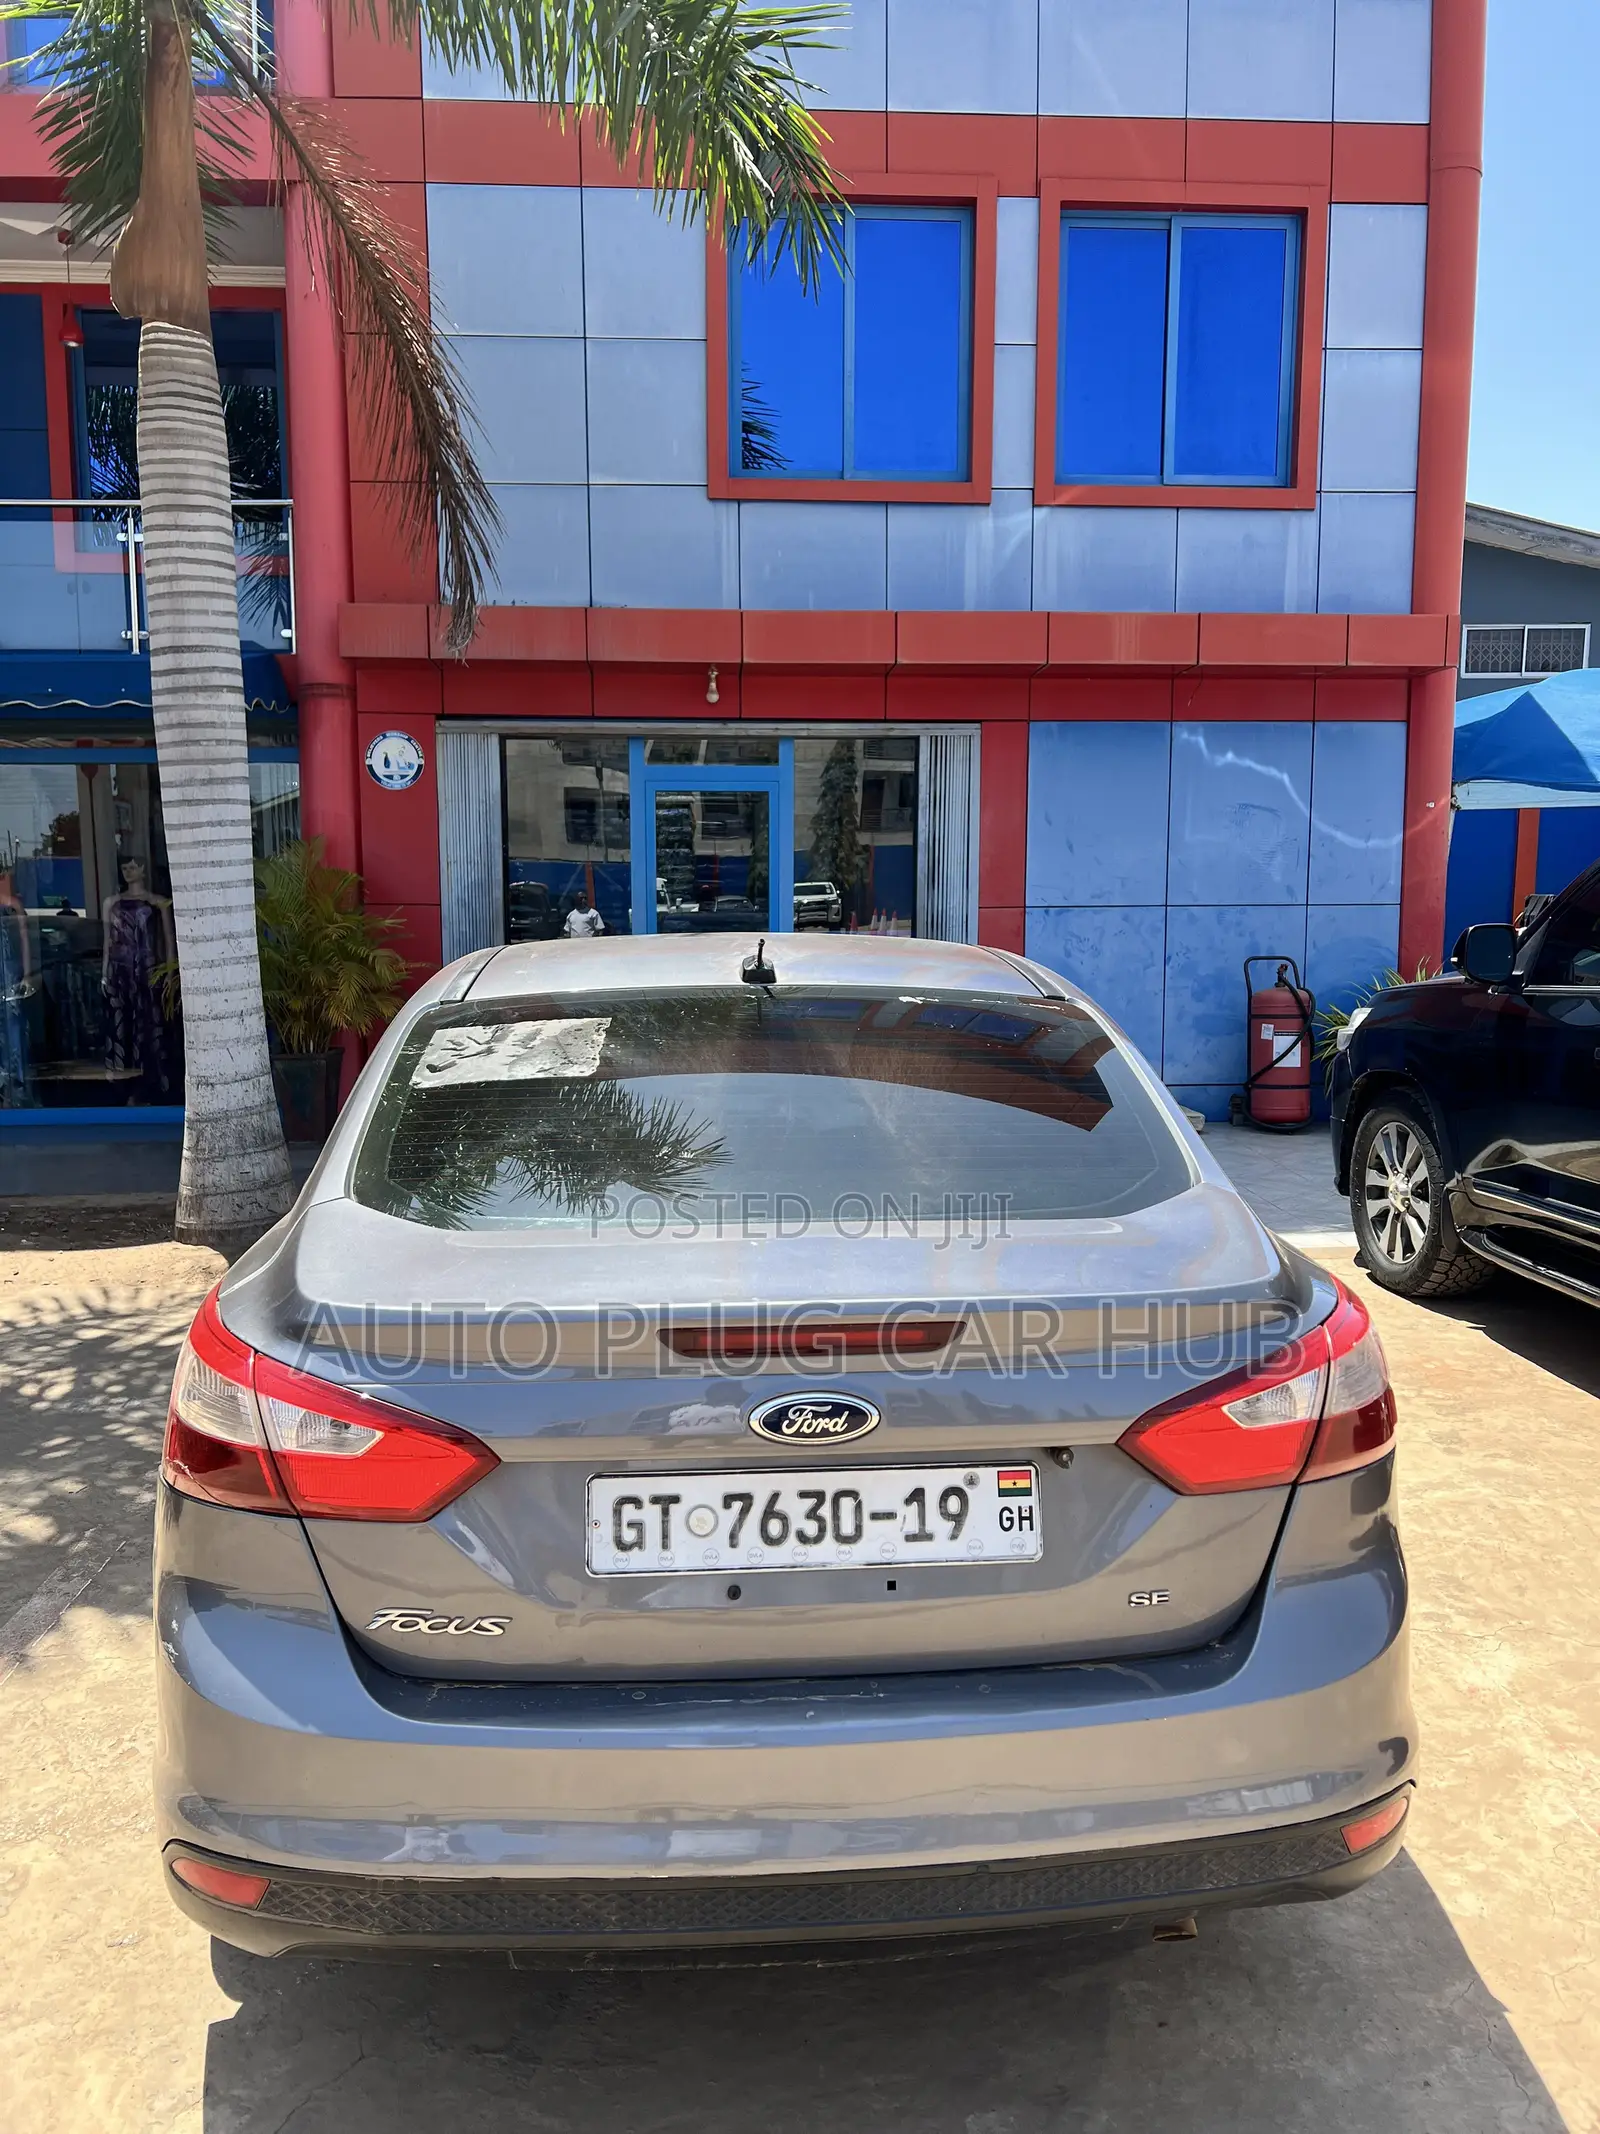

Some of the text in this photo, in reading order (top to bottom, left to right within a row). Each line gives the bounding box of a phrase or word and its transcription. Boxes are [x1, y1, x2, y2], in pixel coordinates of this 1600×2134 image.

[781, 1404, 850, 1435] Ford
[612, 1485, 970, 1552] GT 7630-19
[998, 1504, 1035, 1532] GH
[1128, 1589, 1171, 1608] SE
